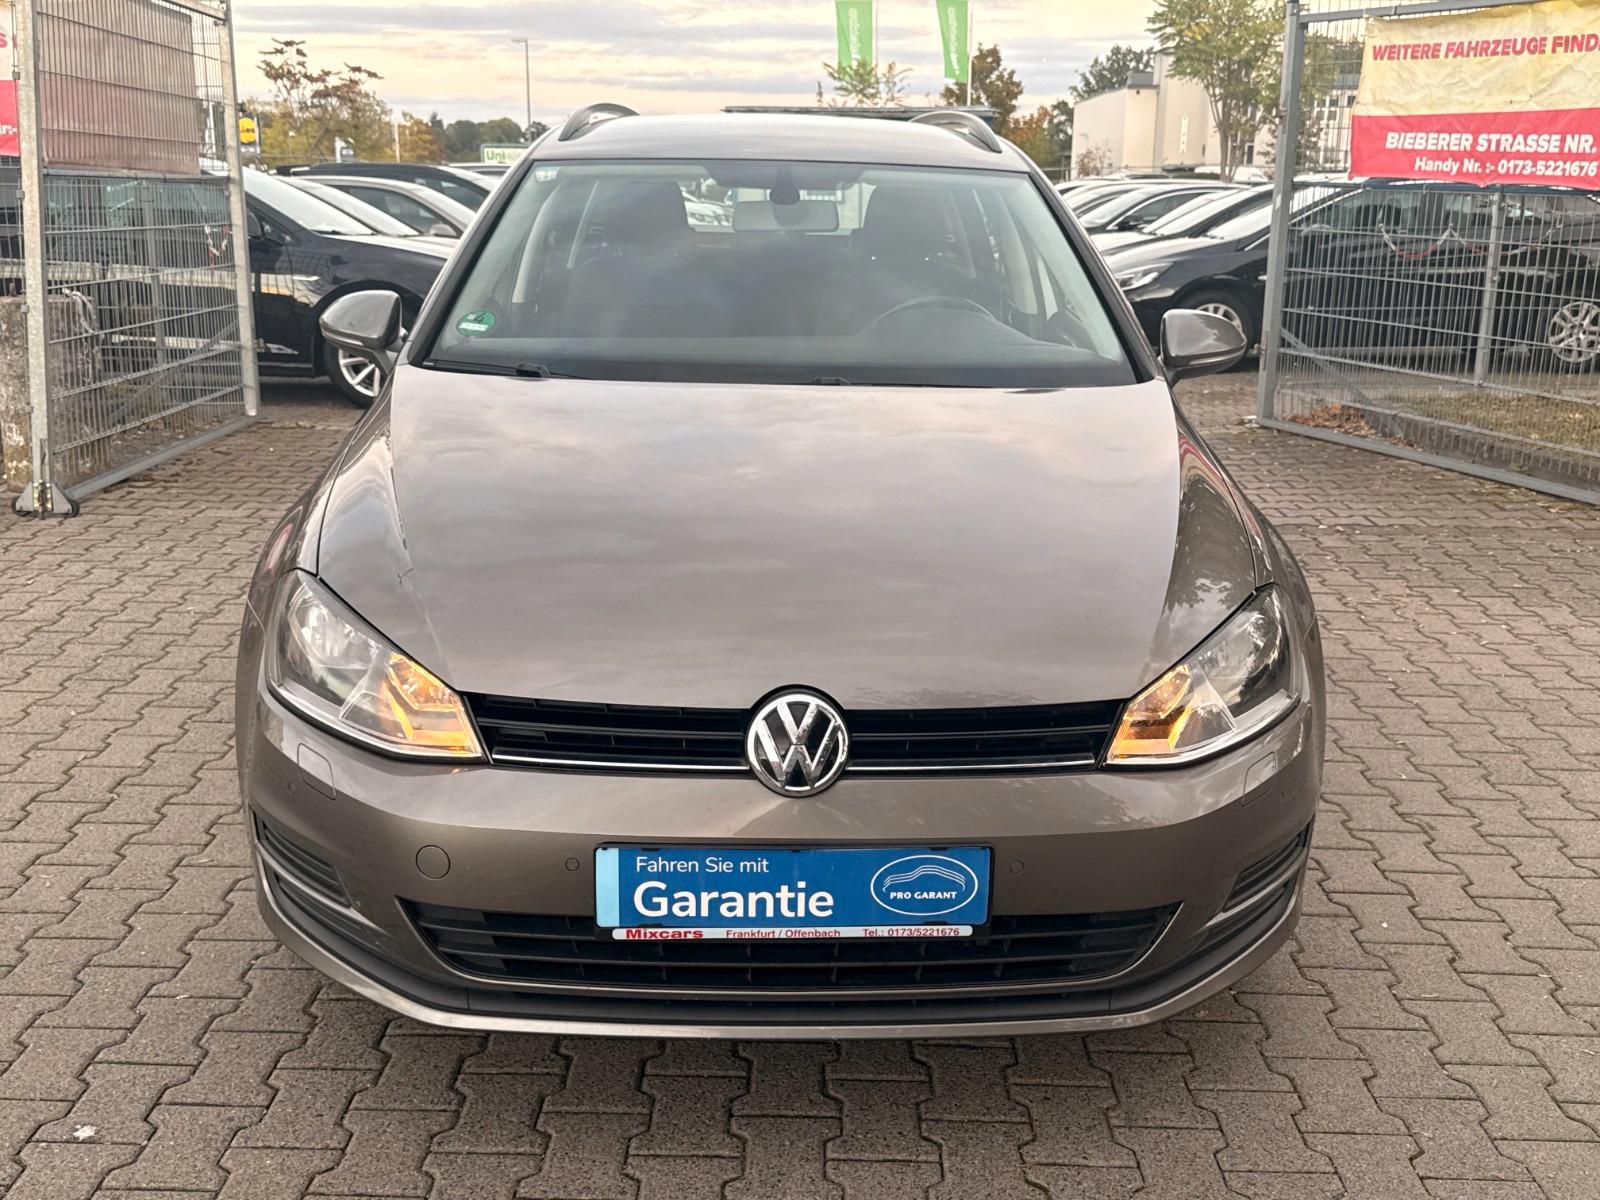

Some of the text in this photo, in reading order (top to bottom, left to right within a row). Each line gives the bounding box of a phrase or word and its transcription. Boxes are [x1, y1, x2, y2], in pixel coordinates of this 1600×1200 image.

[1372, 34, 1600, 61] WEITERE FAHRZEUGE FIND
[1385, 132, 1597, 153] BIEBERER STRASSE NR.
[1414, 157, 1458, 176] Handy
[1462, 158, 1482, 173] Nr.
[1497, 160, 1598, 176] 0173-5221676
[636, 856, 770, 873] Fahren Sie mit
[633, 880, 834, 917] Garantie
[890, 891, 957, 900] PRO GARANT
[626, 928, 704, 940] Mixcars
[726, 929, 776, 939] Frankfurt
[785, 928, 841, 938] Offenbach
[863, 928, 884, 937] Tel.:
[887, 927, 960, 937] 0173/5221676
